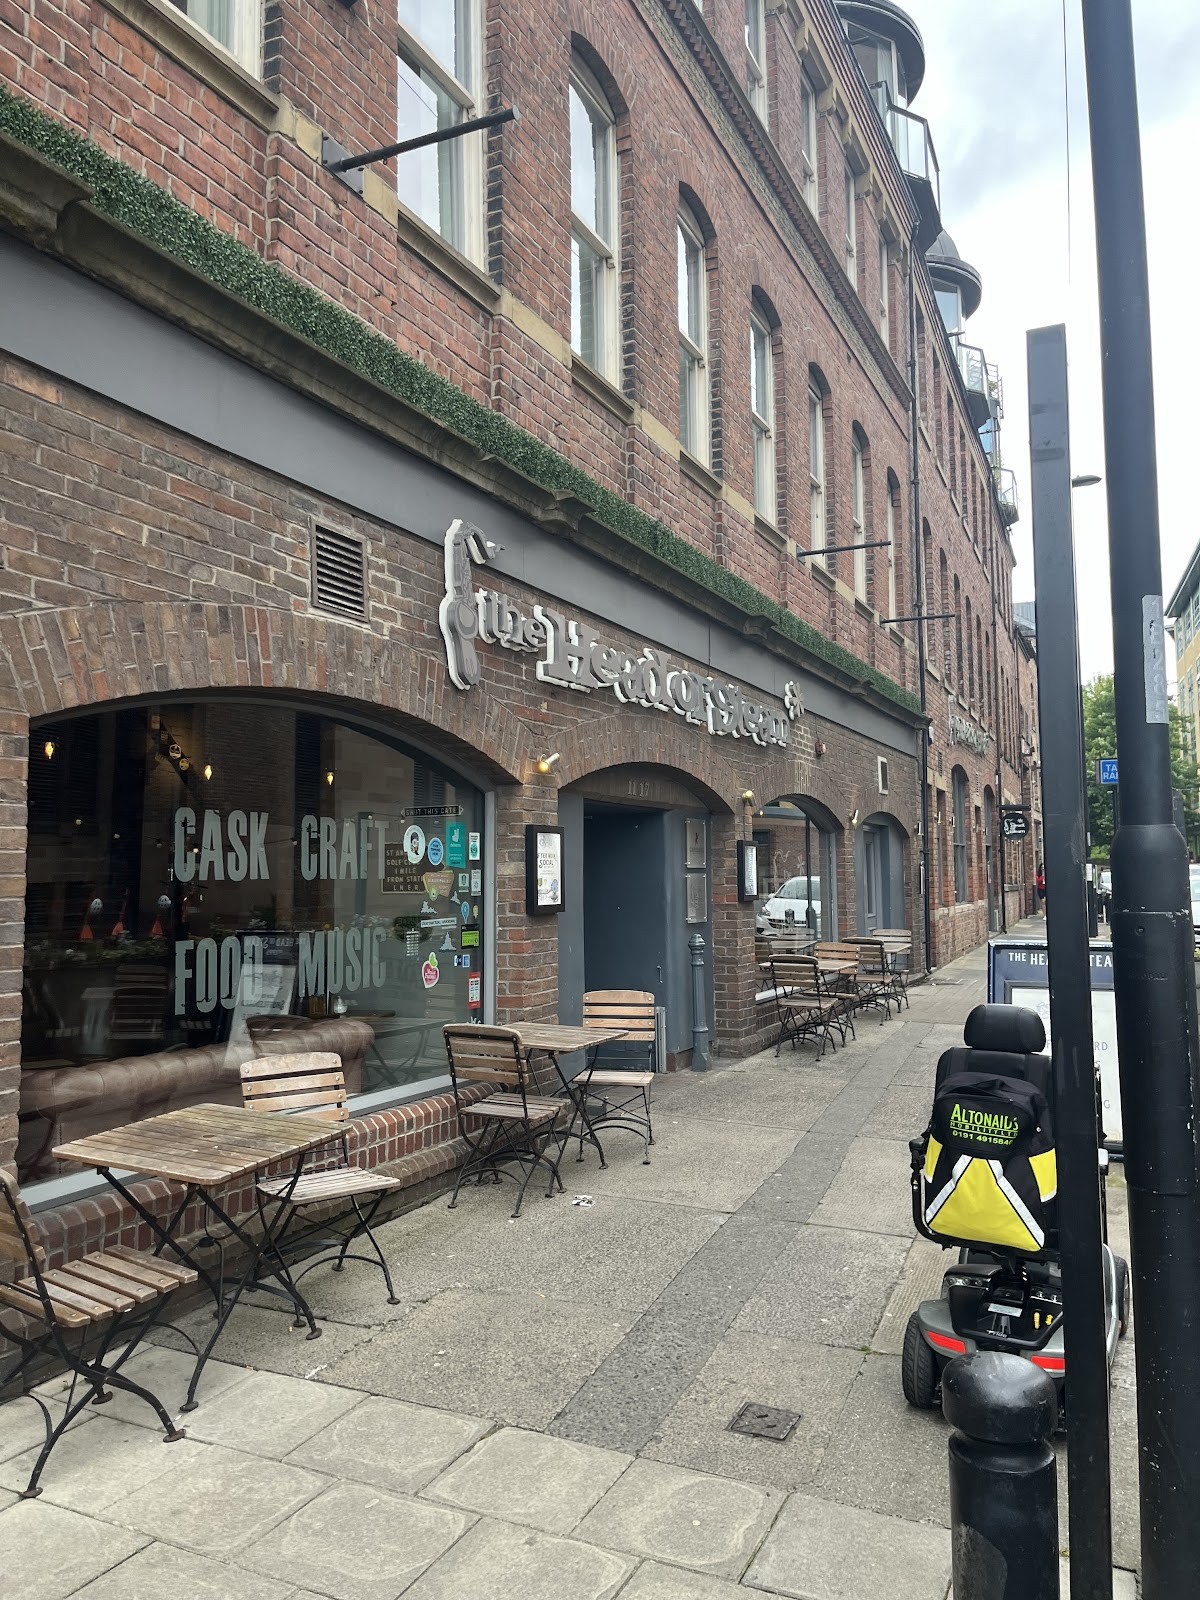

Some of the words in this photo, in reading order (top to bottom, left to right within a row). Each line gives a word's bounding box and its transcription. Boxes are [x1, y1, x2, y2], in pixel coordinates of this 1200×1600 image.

[478, 588, 547, 652] the
[535, 604, 676, 713] Head
[666, 669, 711, 726] of
[706, 679, 792, 748] Steam
[1104, 772, 1118, 780] RA
[174, 806, 270, 883] CASK
[301, 814, 390, 881] CRAFT
[406, 875, 424, 883] STATI
[1008, 952, 1027, 962] THE
[1030, 953, 1049, 966] HE
[1089, 954, 1113, 968] TEA
[174, 935, 264, 1016] FOOD
[299, 927, 386, 998] MUSIC
[950, 1121, 999, 1135] MOBILITY
[1000, 1130, 1018, 1138] LTD
[952, 1129, 974, 1140] 0191
